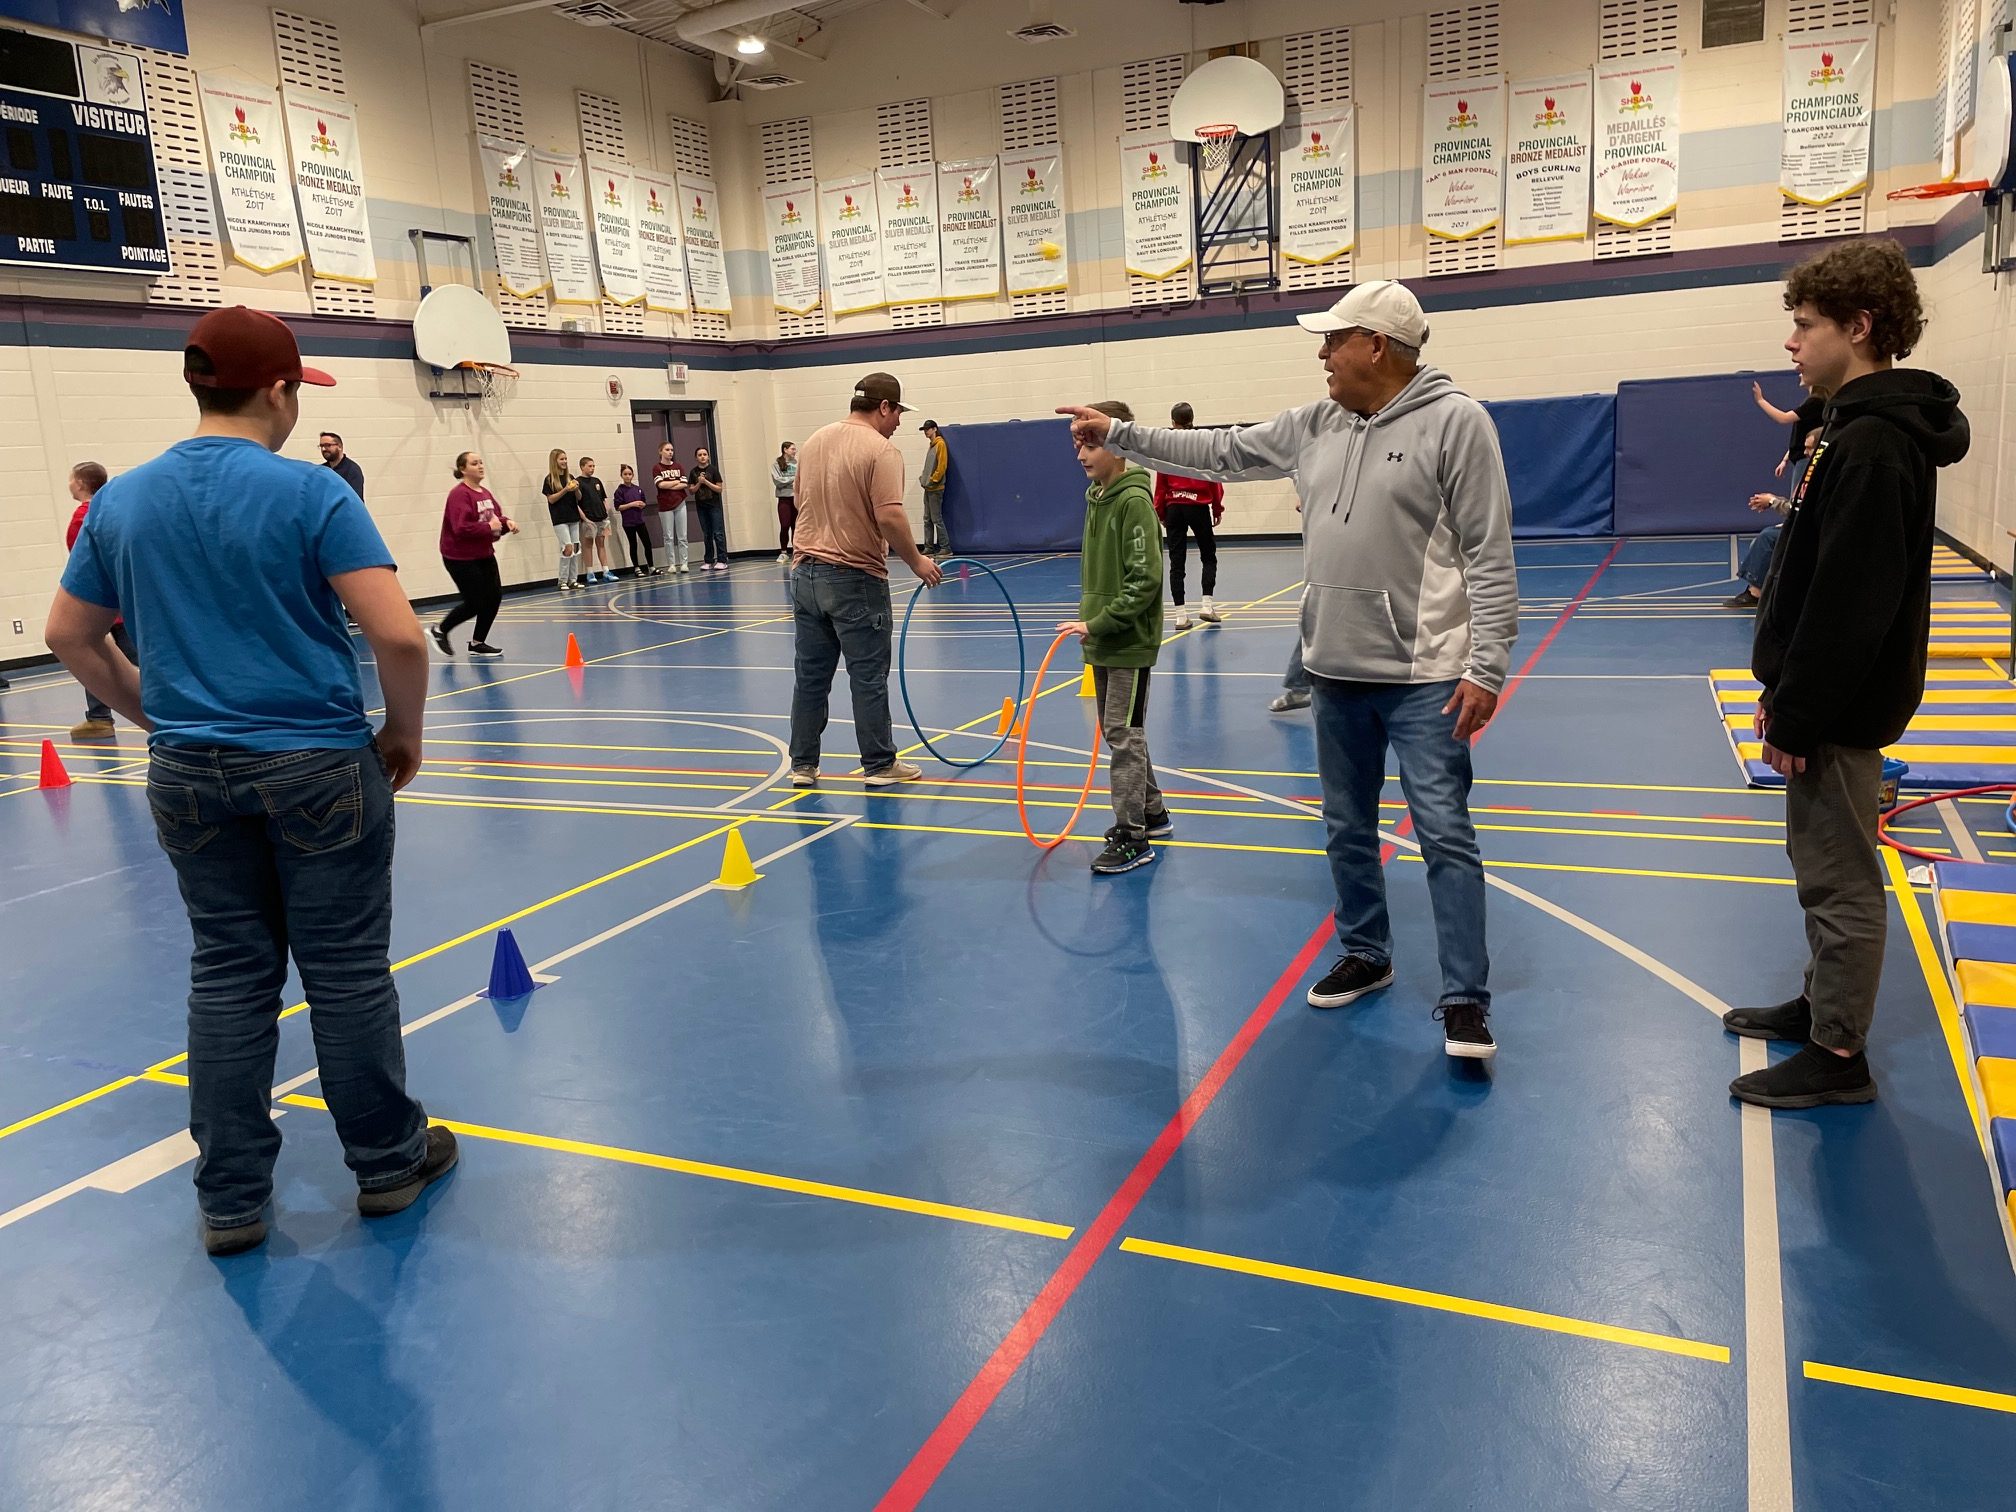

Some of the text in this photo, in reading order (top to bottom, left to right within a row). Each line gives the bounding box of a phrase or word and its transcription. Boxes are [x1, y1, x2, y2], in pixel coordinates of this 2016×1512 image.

[1811, 68, 1844, 78] SHSAA
[1621, 95, 1652, 106] SHSAA
[1791, 93, 1859, 110] CHAMPIONS
[0, 101, 146, 135] ÉRIODE VISITEUR
[1449, 114, 1477, 123] SHSAA
[1535, 111, 1565, 120] SHSAA
[1787, 106, 1863, 123] PROVINCIAUX
[229, 123, 258, 135] SHSAA
[1607, 115, 1665, 135] MEDAILLÉS
[1792, 122, 1868, 134] GARÇONS VOLLEYBALL
[311, 135, 337, 147] SHSAA
[1519, 135, 1578, 151] PROVINCIAL
[1610, 130, 1661, 147] D'ARGENT
[1812, 132, 1834, 140] 2022
[1303, 145, 1330, 154] SHSAA
[1434, 138, 1492, 152] PROVINCIAL
[1605, 142, 1667, 160] PROVINCIAL
[220, 151, 276, 170] PROVINCIAL
[1433, 149, 1491, 164] CHAMPIONS
[1511, 145, 1587, 164] BRONZE MEDALIST
[1143, 164, 1166, 174] SHSAA
[1641, 157, 1676, 170] FOOTBALL
[225, 166, 275, 183] CHAMPION
[301, 161, 354, 182] PROVINCIAL
[1291, 166, 1343, 182] PROVINCIAL
[1465, 167, 1498, 177] FOOTBALL
[1516, 167, 1539, 180] BOYS
[1021, 180, 1043, 188] SHSAA
[1294, 178, 1341, 192] CHAMPION
[1531, 175, 1564, 183] BELLEVUE
[0, 178, 153, 209] UEUR FAUTE FAUTES
[232, 185, 276, 200] ATHLÉTISME
[327, 179, 361, 196] MEDALIST
[1132, 185, 1180, 201] PROVINCIAL
[1617, 184, 1654, 196] Warriors
[84, 198, 109, 211] T.O.L.
[246, 200, 264, 210] 2017
[312, 192, 354, 208] ATHLÉTISME
[490, 196, 530, 212] PROVINCIAL
[1011, 200, 1056, 214] PROVINCIAL
[1135, 195, 1178, 211] CHAMPION
[1296, 194, 1339, 207] ATHLÉTISME
[325, 207, 342, 217] 2017
[492, 208, 532, 223] CHAMPIONS
[543, 207, 579, 219] PROVINCIAL
[948, 210, 991, 222] PROVINCIAL
[1008, 209, 1060, 225] SILVER MEDALIST
[1310, 206, 1327, 215] 2019
[598, 212, 630, 228] PROVINCIAL
[889, 216, 930, 228] PROVINCIAL
[1138, 212, 1177, 224] ATHLÉTISME
[600, 223, 630, 237] CHAMPION
[641, 220, 672, 235] PROVINCIAL
[832, 224, 872, 239] PROVINCIAL
[885, 225, 934, 238] SILVER MEDALIST
[943, 219, 996, 232] BRONZE MEDALIST
[1150, 223, 1166, 232] 2019
[775, 230, 813, 244] PROVINCIAL
[1017, 228, 1053, 238] ATHLÉTISME
[776, 239, 814, 254] CHAMPIONS
[829, 232, 877, 249] SILVER MEDALIST
[18, 237, 167, 263] PARTIE POINTAGE
